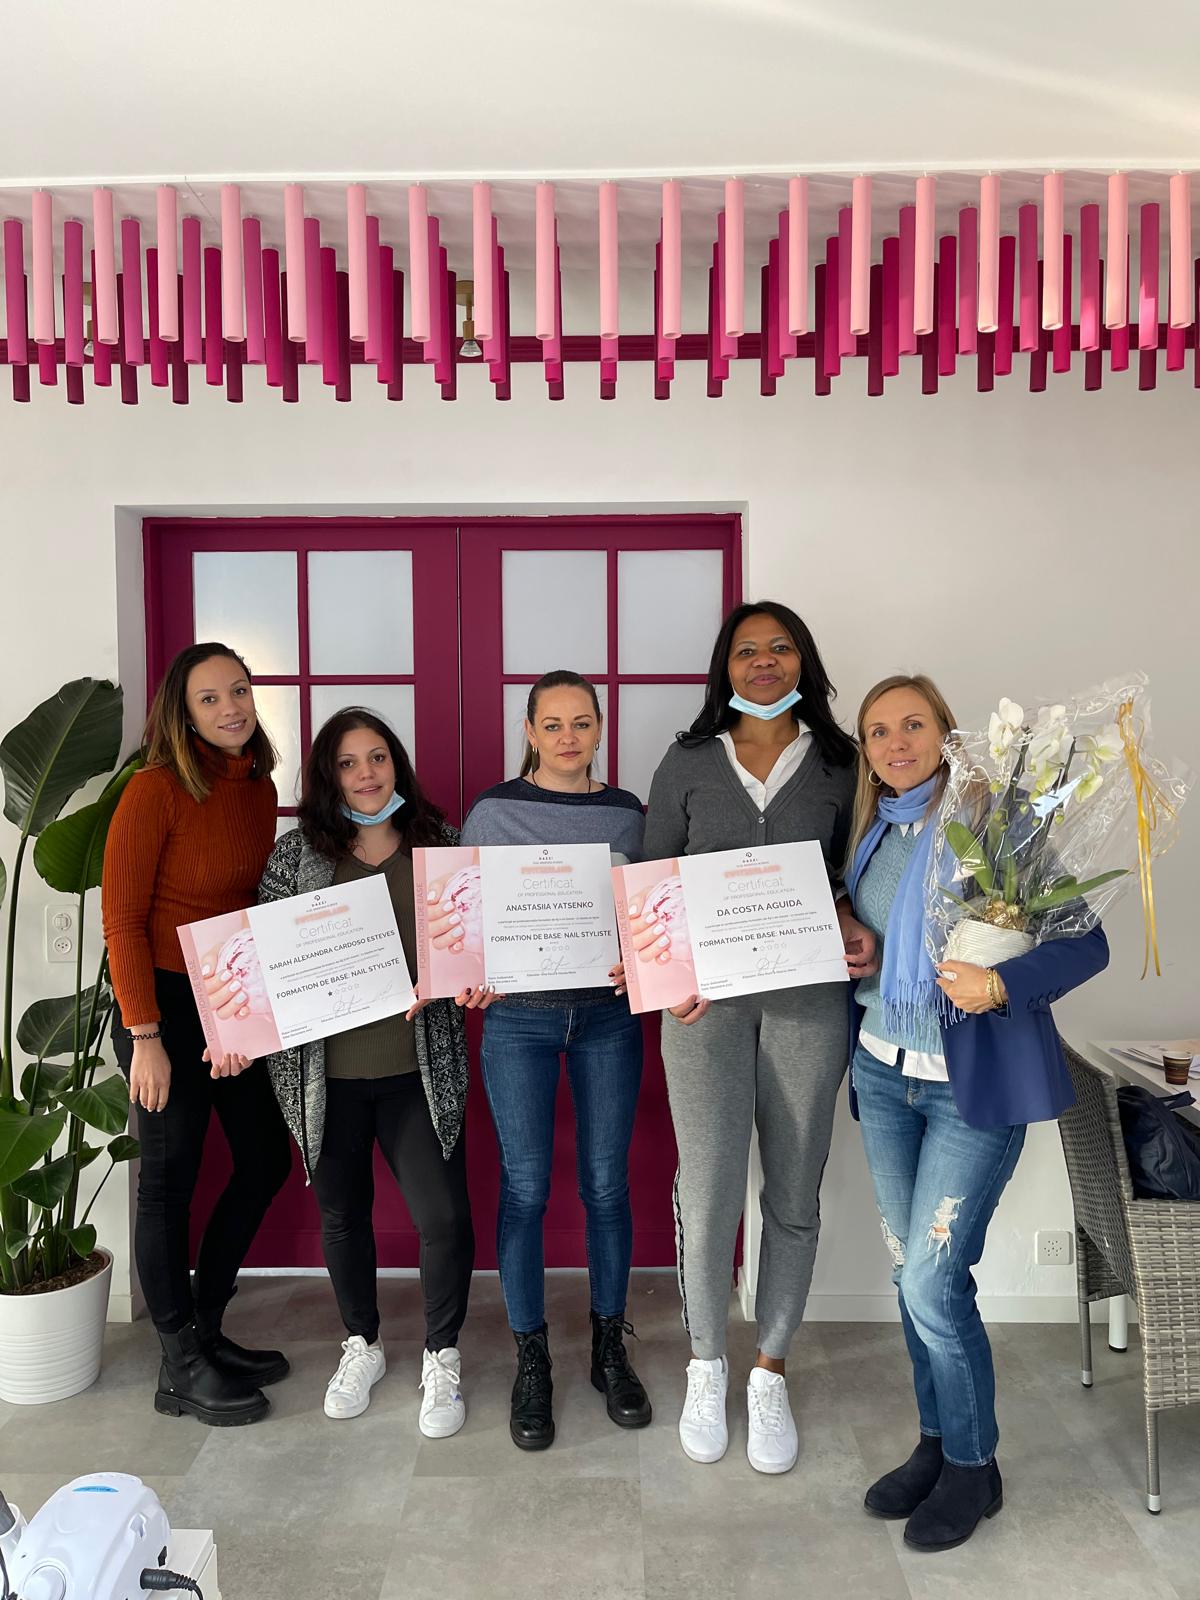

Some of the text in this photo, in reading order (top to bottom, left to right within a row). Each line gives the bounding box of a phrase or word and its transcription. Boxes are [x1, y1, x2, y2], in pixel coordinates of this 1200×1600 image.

[523, 877, 574, 890] Certificat
[727, 877, 785, 893] Certificat
[506, 901, 594, 912] ANASTASIIA YATSENKO
[716, 899, 803, 917] DA COSTA AGUIDA
[298, 917, 353, 940] Certificat
[416, 881, 426, 969] FORMATION DE BASE
[490, 934, 532, 943] FORMATION
[564, 930, 580, 938] NAIL
[581, 929, 612, 938] STYLISTE
[698, 935, 744, 948] FORMATION
[798, 923, 834, 934] STYLISTE
[268, 958, 293, 971] SARAH
[293, 947, 333, 964] ALEXANDRA
[333, 938, 366, 952] CARDOSO
[366, 929, 396, 943] ESTEVES
[276, 980, 319, 999] FORMATION
[319, 978, 330, 987] DE
[350, 967, 368, 978] NAIL
[368, 957, 400, 973] STYLISTE
